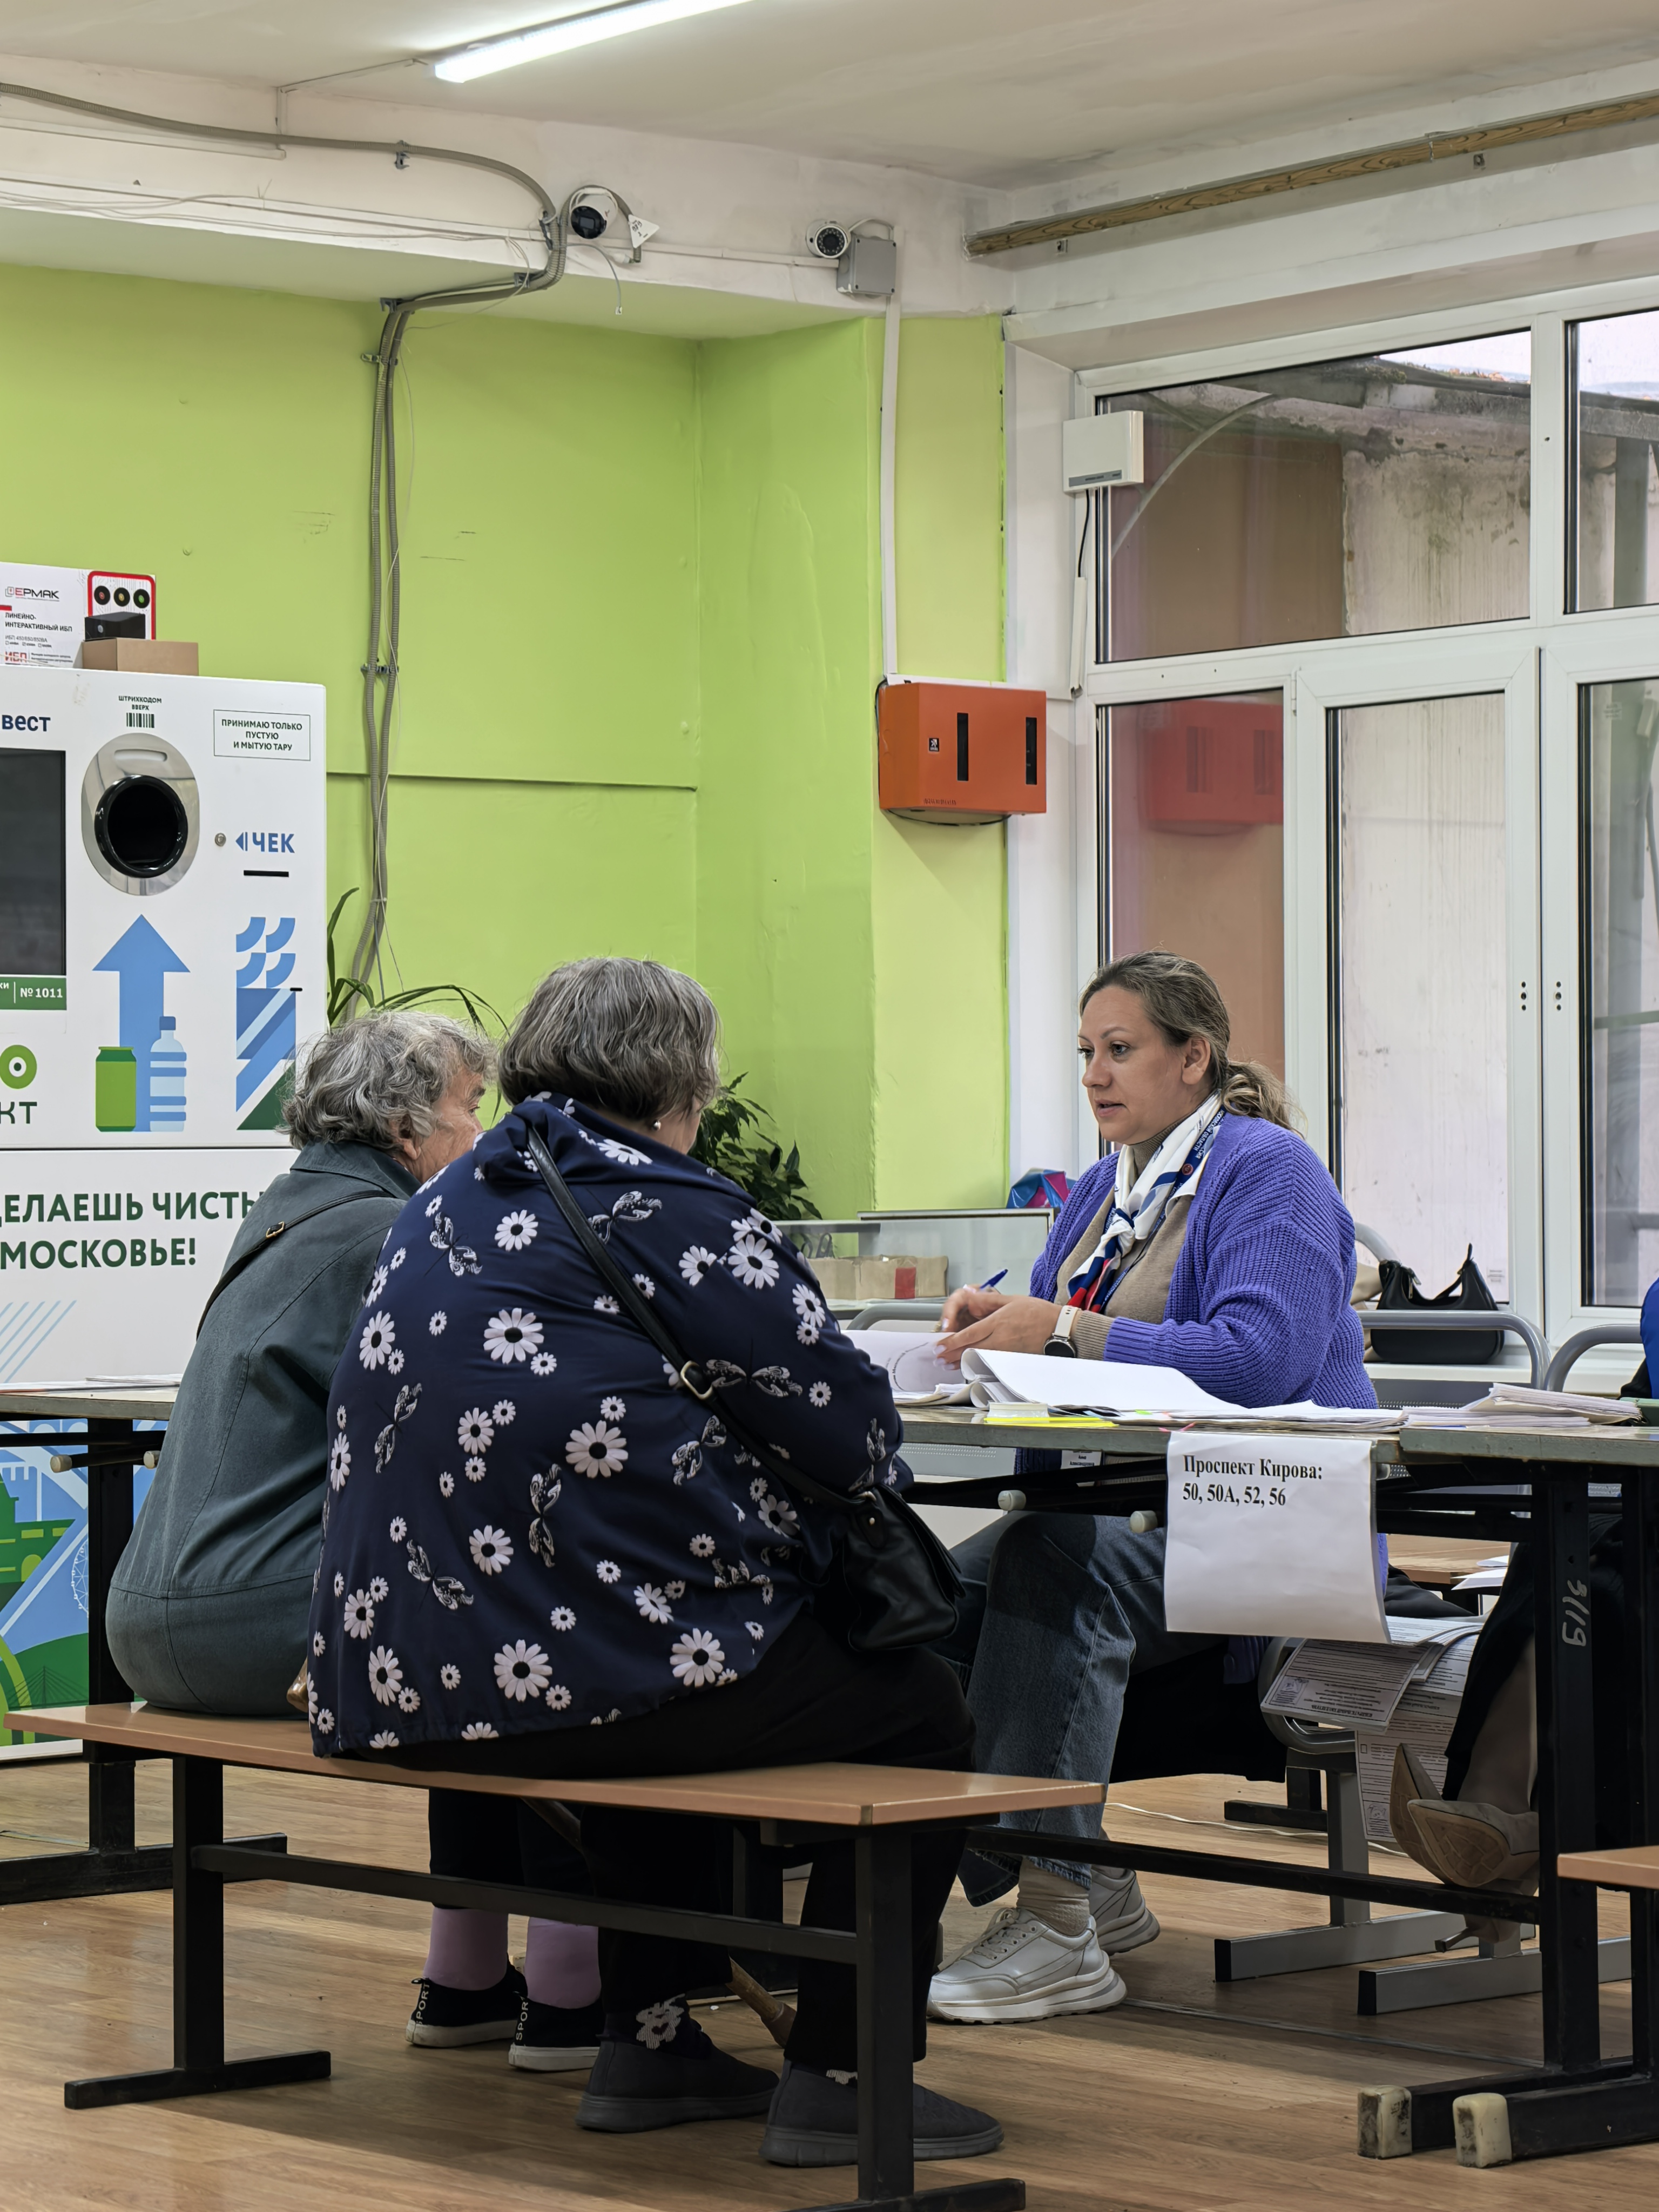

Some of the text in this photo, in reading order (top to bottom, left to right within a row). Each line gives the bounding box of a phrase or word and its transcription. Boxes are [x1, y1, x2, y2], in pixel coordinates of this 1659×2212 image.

[15, 587, 59, 599] ЕРМАК
[5, 612, 37, 621] ЛИНЕЙНО-
[5, 621, 58, 631] ИНТЕРАКТИВНЫЙ
[118, 695, 161, 703] ШТРИХКОДОМ
[221, 719, 302, 730] ПРИНИМАЮ ТОЛЬКО
[246, 731, 279, 739] ПУСТУЮ
[241, 741, 272, 750] МЫТУЮ
[252, 832, 295, 853] ЧЕК
[35, 988, 63, 998] 1011
[1193, 1131, 1209, 1151] ОБЛАСТИ
[0, 1192, 143, 1228] ЕЛАЕШЬ
[1, 1238, 195, 1269] МОСКОВЬЕ!
[1183, 1454, 1323, 1482] Проспект Кирова:
[1183, 1482, 1286, 1508] 50, 50А, 52, 56
